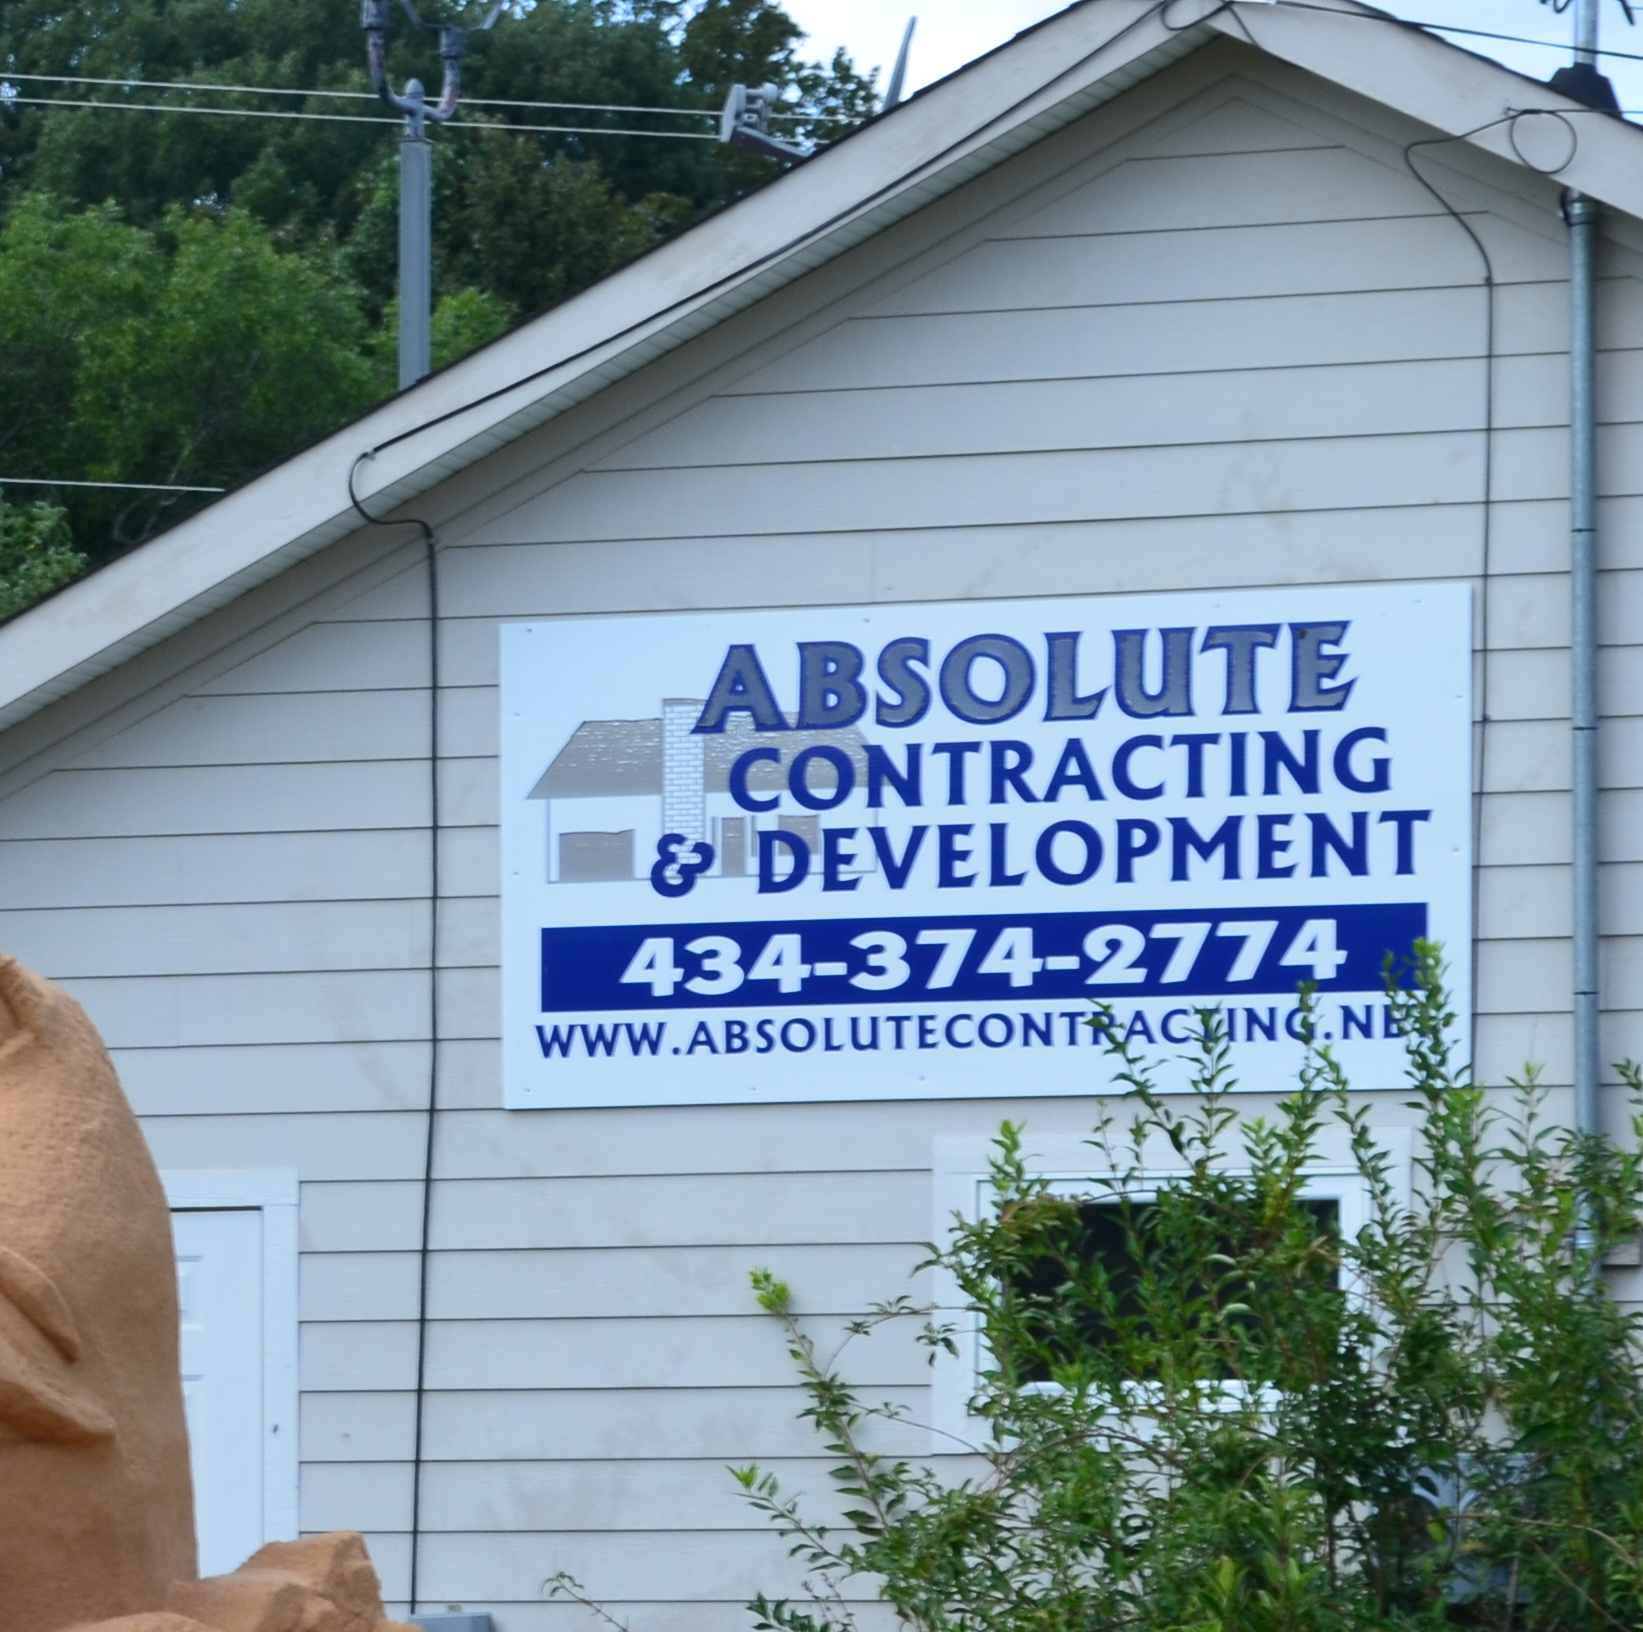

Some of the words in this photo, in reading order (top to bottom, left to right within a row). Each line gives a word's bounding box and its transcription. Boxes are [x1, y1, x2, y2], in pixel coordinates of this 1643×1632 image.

[691, 620, 1359, 735] ABSOLUTE
[729, 726, 1392, 811] CONTRACTING
[650, 832, 713, 897] &
[757, 810, 1432, 894] DEVELOPMENT
[620, 918, 1348, 998] 434-374-2774
[535, 1003, 1428, 1058] WWW.ABSOLUTECONTRACTING.NE
